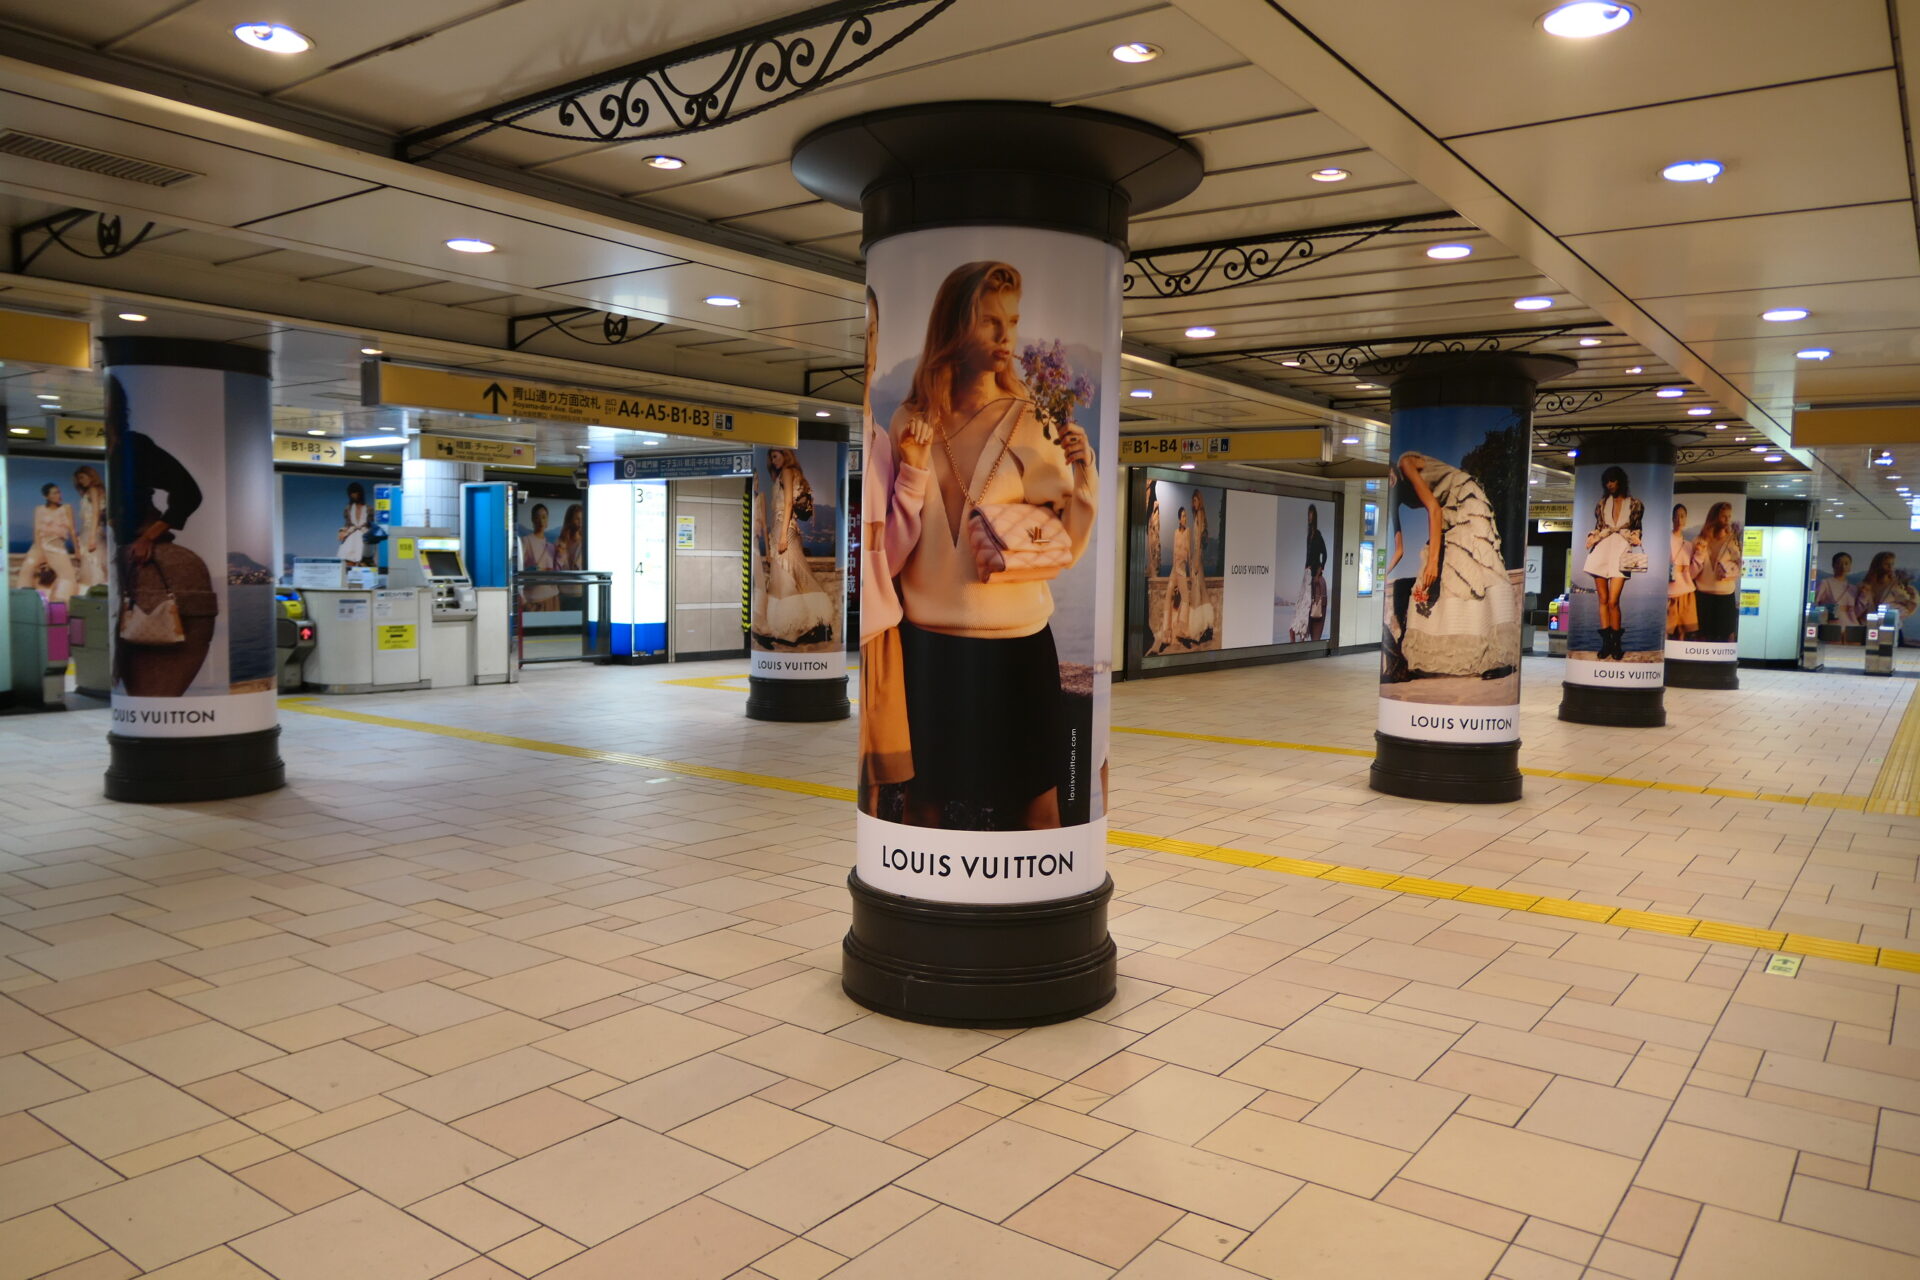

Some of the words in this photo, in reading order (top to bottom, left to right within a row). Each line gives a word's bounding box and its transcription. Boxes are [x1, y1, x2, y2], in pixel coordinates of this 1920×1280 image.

[512, 386, 601, 410] 青山通り方面改札
[636, 488, 644, 503] 3
[635, 561, 644, 575] 4
[1231, 564, 1247, 575] LOUIS
[1248, 564, 1269, 575] VUITTON
[1685, 647, 1710, 655] LOUIS
[757, 660, 782, 670] LOUIS
[785, 661, 828, 671] VUITTON
[1594, 669, 1625, 679] LOUIS
[113, 708, 136, 723] OUIS
[141, 710, 215, 724] VUITTON
[1411, 715, 1454, 730] LOUIS
[1460, 718, 1513, 731] VUITTON
[1067, 728, 1077, 801] louisvuitton.com
[883, 845, 951, 877] LOUIS
[961, 851, 1073, 879] VUITTON
